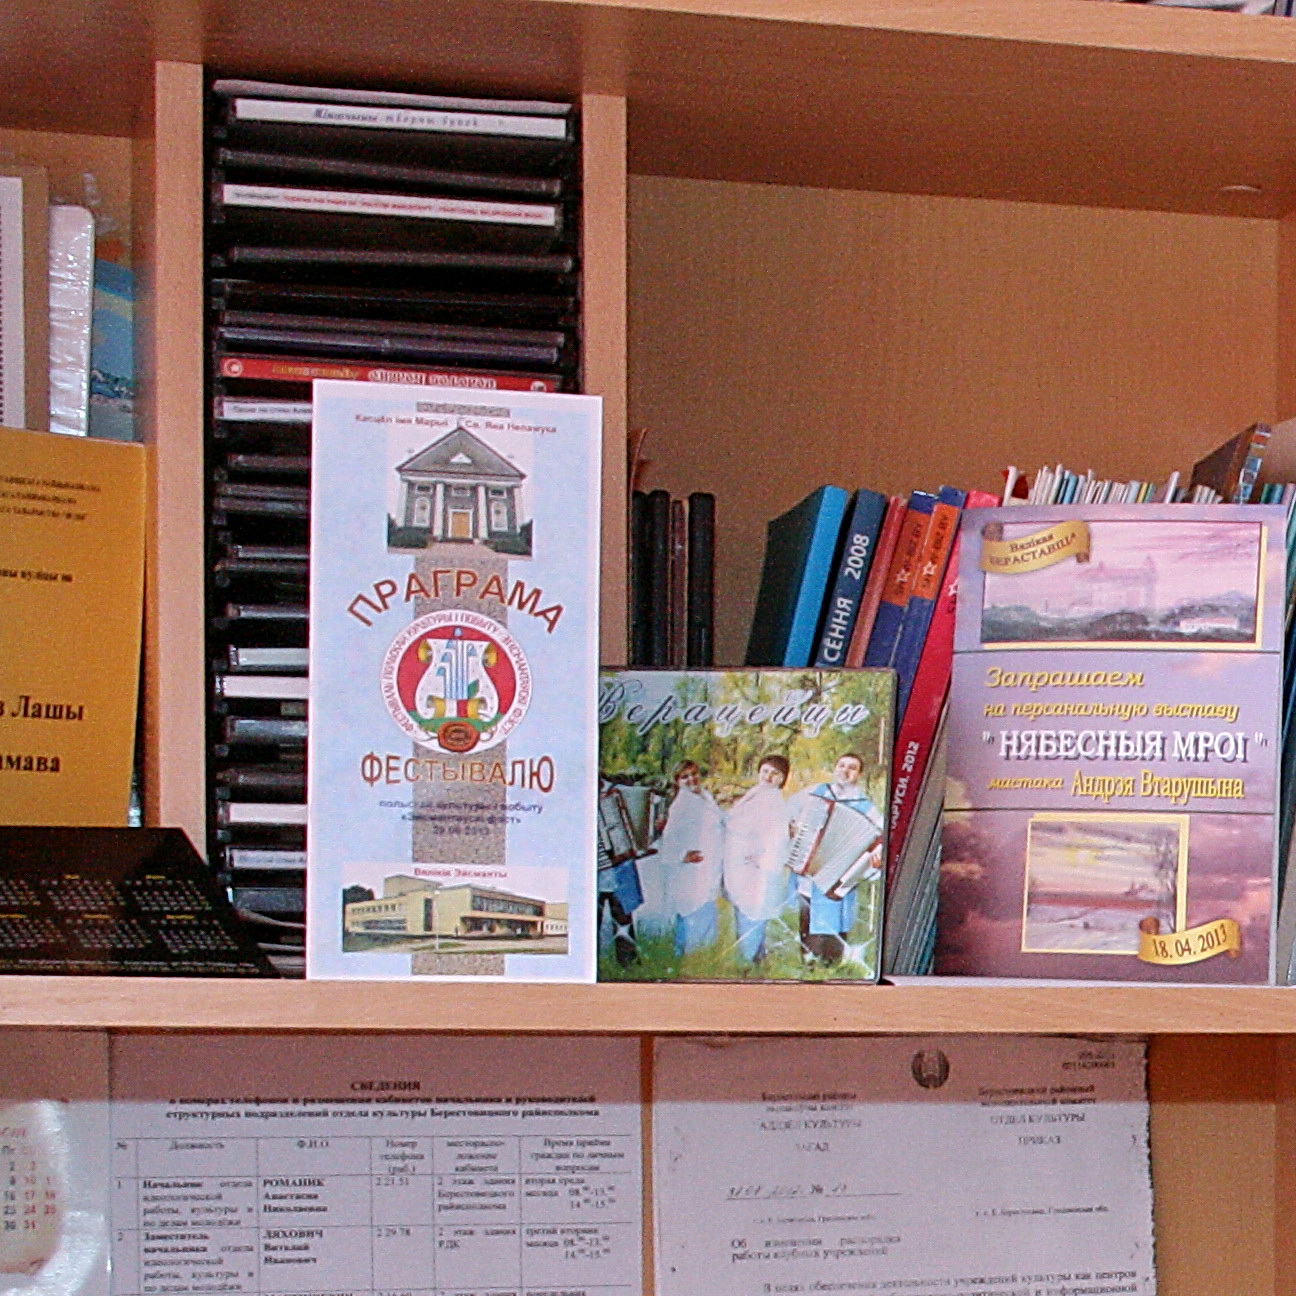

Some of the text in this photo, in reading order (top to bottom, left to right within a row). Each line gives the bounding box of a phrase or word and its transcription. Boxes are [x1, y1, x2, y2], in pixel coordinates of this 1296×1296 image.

[845, 534, 870, 580] 2008
[347, 569, 565, 634] ПРАГРАМА
[984, 667, 1145, 691] Запрашаем
[12, 696, 84, 721] Лашы
[984, 703, 1239, 723] на персанальную выставу
[0, 752, 60, 773] мава
[903, 741, 921, 776] 2012
[999, 730, 1249, 762] НЯБЕСНЫЯ МРОІ
[361, 751, 555, 793] ФЕСТЫВАЛЮ
[988, 770, 1245, 804] мастака Андрэя Втарушына
[1152, 923, 1228, 960] 18. 04. 2013
